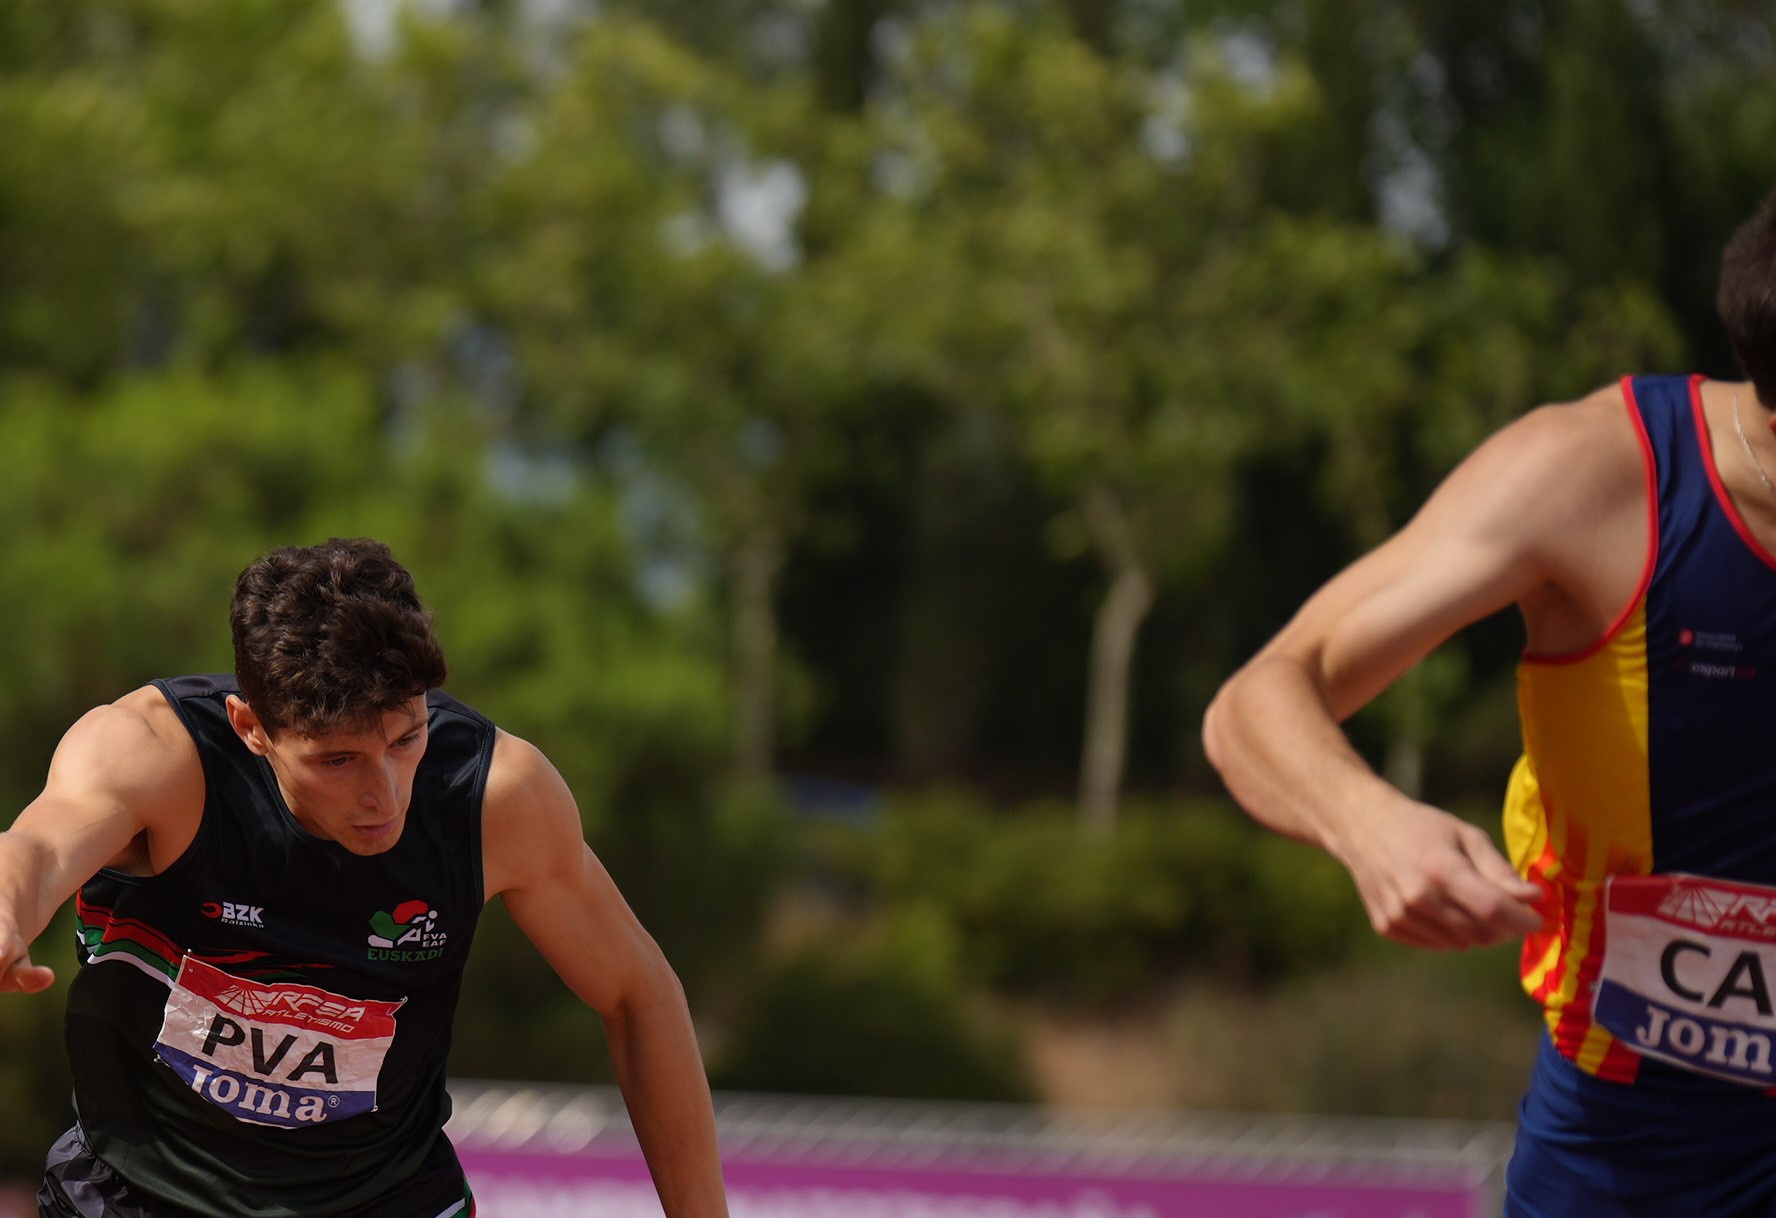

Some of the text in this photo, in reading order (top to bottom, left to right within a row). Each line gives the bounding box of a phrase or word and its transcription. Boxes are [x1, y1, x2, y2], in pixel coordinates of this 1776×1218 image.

[222, 901, 264, 924] BZK
[422, 939, 446, 948] EAF
[423, 932, 448, 940] FVA
[367, 947, 444, 962] EUSKADI
[262, 1009, 355, 1033] ATLETISMO
[201, 1012, 338, 1084] PVA
